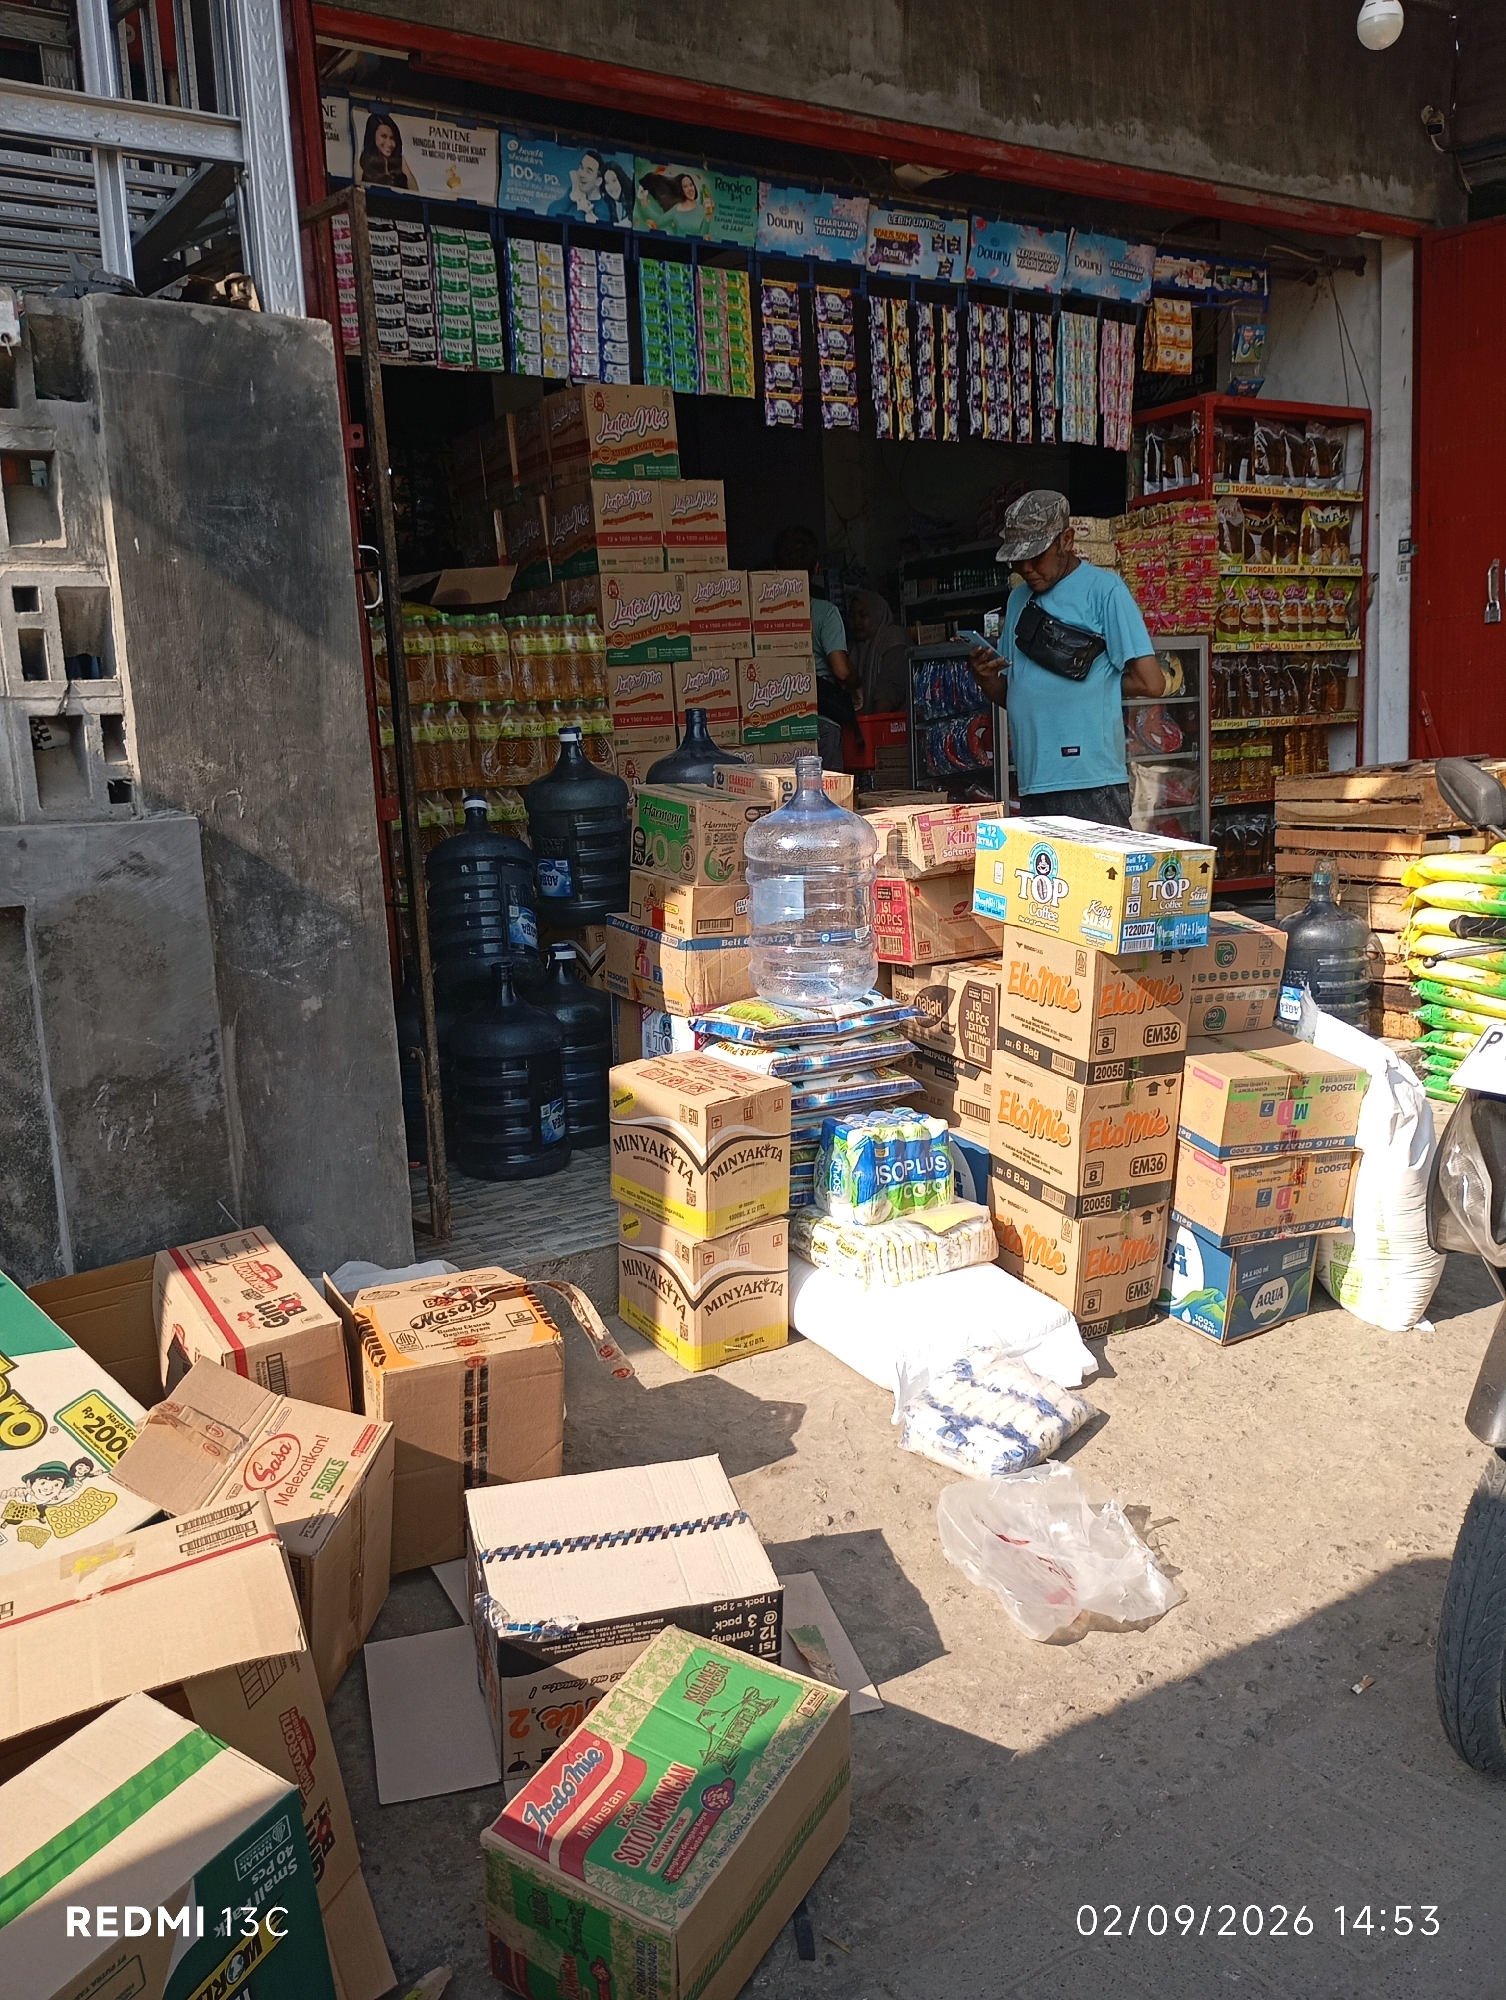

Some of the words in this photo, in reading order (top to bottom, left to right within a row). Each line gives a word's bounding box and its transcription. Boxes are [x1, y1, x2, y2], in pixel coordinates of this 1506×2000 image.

[429, 126, 471, 143] PANTENE
[412, 137, 436, 150] HINGGA
[451, 143, 469, 155] LEBIH
[470, 147, 487, 157] KUAT
[508, 163, 542, 183] 100%
[715, 176, 752, 195] Rejoice
[766, 212, 803, 235] Downy
[813, 216, 859, 231] KEHARUMAN
[888, 213, 912, 228] LEBIH
[913, 216, 945, 232] UNTUNG!
[815, 226, 837, 238] TIADA
[837, 228, 858, 240] TARA!
[874, 228, 894, 240] BONUS
[883, 246, 906, 261] Downy
[976, 244, 1011, 267] Downy
[1016, 247, 1061, 264] KEHARUMAN
[1017, 258, 1037, 271] TIADA
[1074, 254, 1103, 276] Downy
[1232, 485, 1263, 495] TROPICAL
[1245, 565, 1275, 573] TROPICAL
[1284, 566, 1296, 574] Liter
[649, 591, 681, 621] Mas
[651, 622, 676, 636] GORENG
[1263, 717, 1292, 727] TROPICAL
[642, 801, 684, 831] Harmony
[702, 820, 742, 831] Harmony
[986, 825, 998, 836] 12
[1126, 863, 1144, 872] EXTRA
[1137, 855, 1146, 863] 12
[1014, 868, 1069, 906] TOP
[1147, 878, 1190, 901] TOP
[881, 902, 891, 914] ISI
[1028, 902, 1059, 923] Coffee
[1088, 900, 1112, 918] Kopi
[1128, 902, 1138, 913] 10
[1159, 900, 1183, 910] Coffee
[887, 914, 903, 926] PCS
[1082, 908, 1113, 931] Susu
[1125, 923, 1155, 936] 1220074
[721, 938, 741, 947] Beli
[1008, 960, 1081, 1013] EkoMie
[972, 999, 982, 1012] ISI
[1099, 974, 1184, 1019] EkoMie
[916, 995, 943, 1018] nabati
[965, 1010, 976, 1022] 30
[976, 1013, 990, 1026] PCS
[968, 1022, 987, 1036] EXTRA
[1146, 1025, 1179, 1044] EM36
[1023, 1042, 1040, 1061] Bag
[1101, 1036, 1109, 1048] 8
[1095, 1064, 1124, 1080] 20056
[1319, 1083, 1356, 1093] 1250046
[997, 1089, 1072, 1148] EkoMie
[1295, 1103, 1308, 1120] M
[1085, 1107, 1171, 1153] EkoMie
[1273, 1141, 1312, 1151] GRATIS
[1324, 1138, 1346, 1148] Beli
[613, 1133, 694, 1187] MINYAKITA
[710, 1142, 783, 1183] MINYAKITA
[1132, 1155, 1164, 1175] EM36
[1314, 1162, 1351, 1174] 1250051
[875, 1155, 948, 1185] ISOPLUS
[1089, 1169, 1097, 1181] 8
[1013, 1171, 1030, 1191] Bag
[1083, 1197, 1111, 1213] 20056
[1084, 1235, 1160, 1282] EkoMie
[621, 1258, 686, 1322] MINYAKITA
[703, 1276, 784, 1317] MINYAKITA
[1255, 1286, 1285, 1309] AQUA
[1087, 1297, 1096, 1310] 8
[412, 1297, 491, 1330] Masako
[1194, 1313, 1215, 1329] 100%
[1082, 1320, 1109, 1336] 20056
[1192, 1318, 1218, 1335] MURNI
[105, 1411, 128, 1431] Harga
[252, 1440, 293, 1483] Sasa
[273, 1434, 331, 1507] Melezatkan!
[322, 1466, 342, 1493] 5000
[713, 1602, 728, 1613] pcs
[744, 1596, 765, 1608] pack
[747, 1613, 757, 1626] 3
[763, 1610, 778, 1625] @
[711, 1628, 755, 1644] renteng
[759, 1625, 776, 1640] 12
[758, 1640, 776, 1653] Isi
[682, 1660, 722, 1703] KULINER
[695, 1664, 732, 1706] INDONESIA
[508, 1709, 530, 1740] 2
[522, 1746, 605, 1850] Indomie
[634, 1760, 699, 1833] LAMONGAN
[577, 1819, 597, 1841] Mi
[595, 1788, 627, 1826] Instan
[616, 1801, 643, 1829] RASA
[708, 1858, 719, 1869] PT
[741, 1812, 752, 1825] CBP
[750, 1789, 769, 1812] SUKSES
[785, 1752, 796, 1765] Tbk
[240, 1842, 273, 1872] HALAL
[275, 1844, 294, 1864] 40
[612, 1827, 658, 1868] SOTO
[651, 1852, 664, 1868] KHAS
[662, 1835, 676, 1853] JAWA
[664, 1848, 685, 1877] Lengkap
[681, 1825, 700, 1849] dengan
[677, 1849, 694, 1877] Sambal
[690, 1835, 703, 1852] Soto
[250, 1860, 276, 1885] Pcs
[257, 1856, 298, 1903] Small
